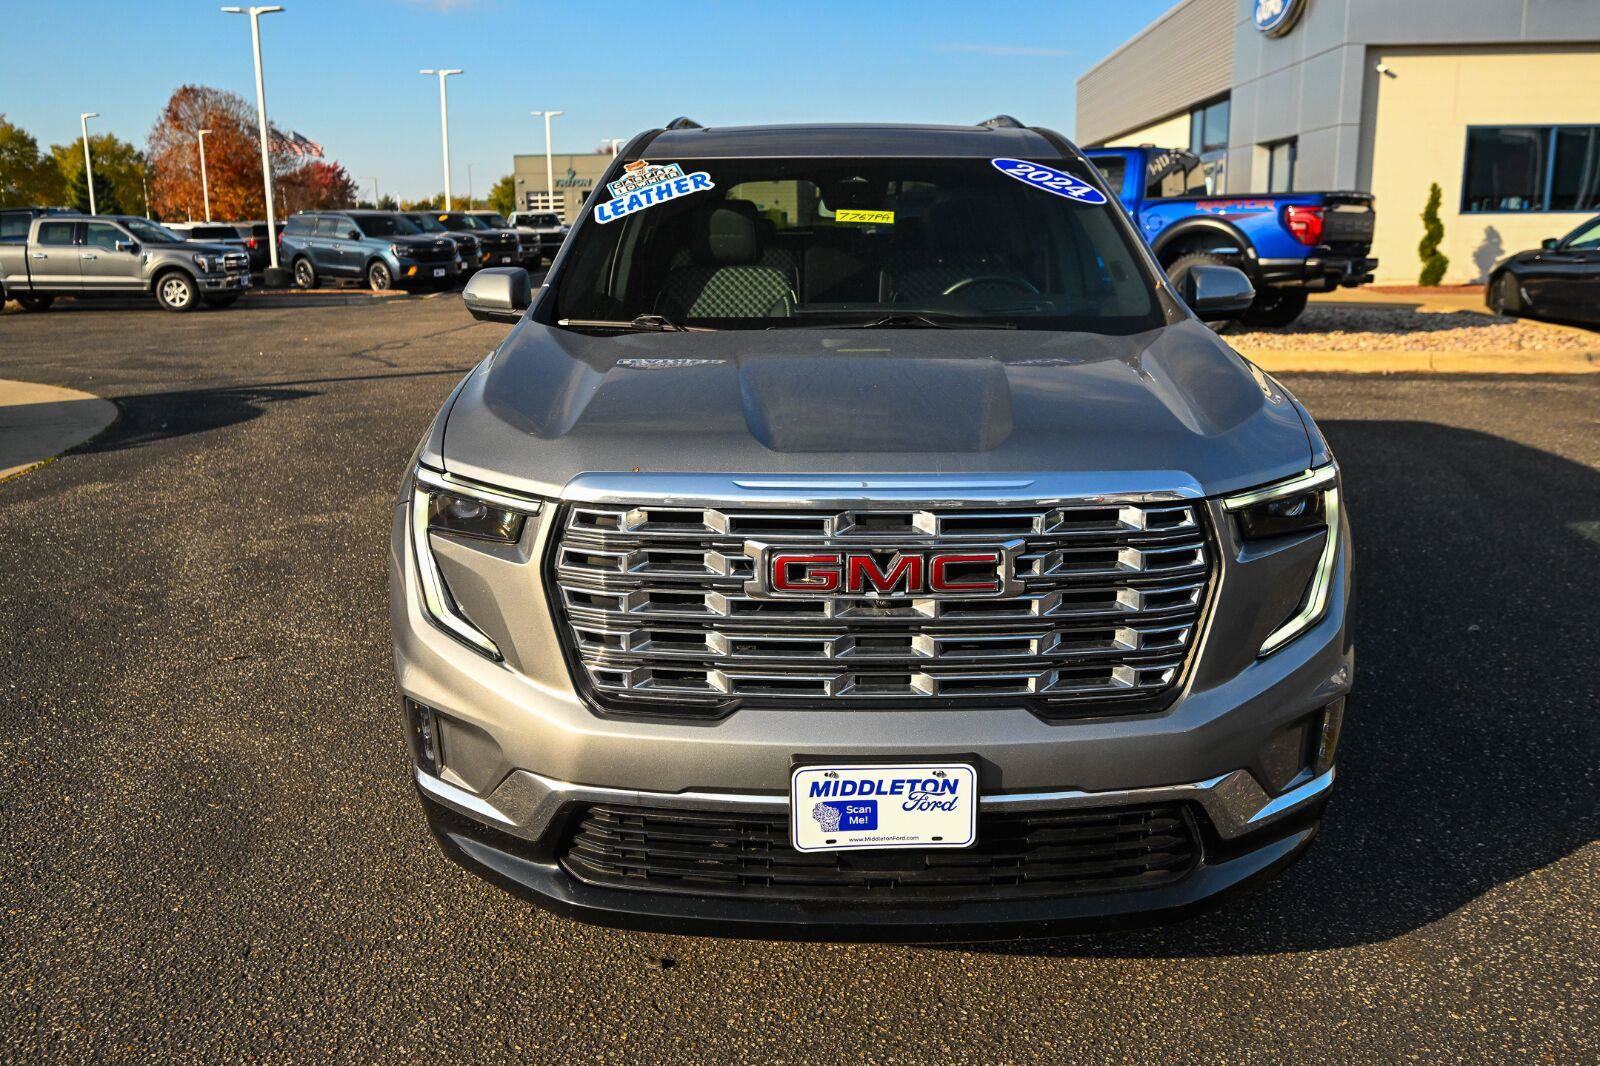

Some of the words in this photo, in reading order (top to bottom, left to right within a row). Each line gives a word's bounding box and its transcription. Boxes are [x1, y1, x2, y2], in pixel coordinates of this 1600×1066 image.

[1005, 164, 1092, 198] 2024
[598, 174, 712, 221] LEATHER
[839, 212, 891, 221] 7767PA
[772, 553, 1001, 594] GMC
[809, 778, 959, 798] MIDDLETON
[846, 805, 872, 814] Scan
[902, 790, 959, 812] Ford
[849, 816, 869, 824] Me!
[848, 835, 920, 843] www.MiddletonFord.com
